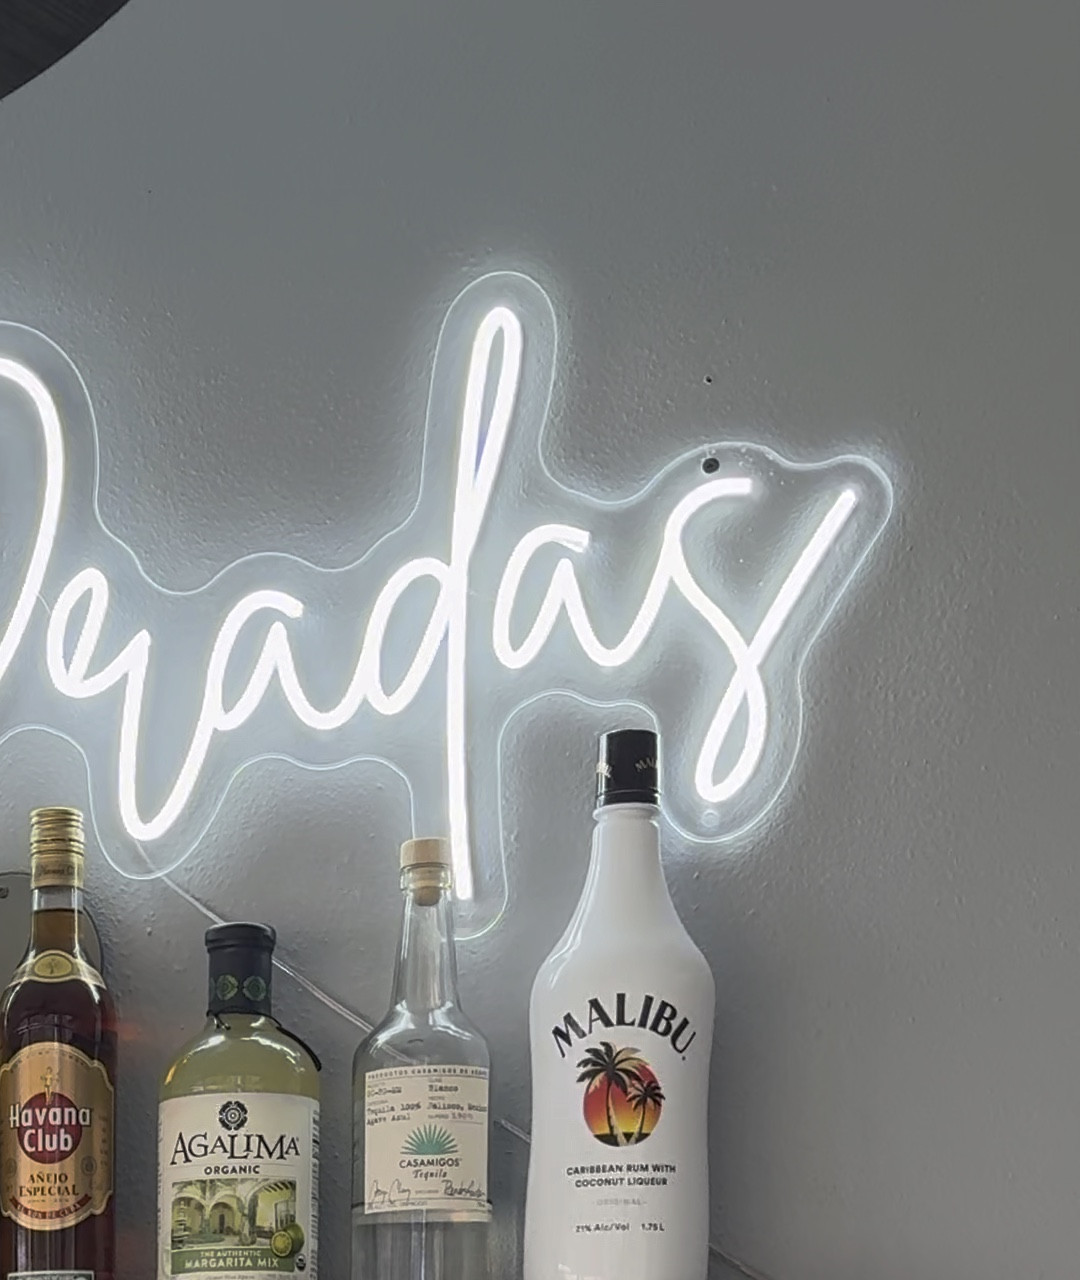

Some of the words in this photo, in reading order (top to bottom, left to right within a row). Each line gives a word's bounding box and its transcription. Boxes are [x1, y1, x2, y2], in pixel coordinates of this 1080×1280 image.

[551, 992, 697, 1059] MALIBU
[428, 1084, 459, 1093] Blanco
[9, 1103, 91, 1128] Havana
[366, 1105, 396, 1117] Tequila
[366, 1117, 387, 1127] Agave
[391, 1113, 411, 1122] Azul
[23, 1128, 73, 1152] Club
[170, 1131, 300, 1166] AGALIMA
[399, 1157, 461, 1169] CASAMIGOS
[566, 1163, 624, 1176] CARIBBEAN
[626, 1163, 650, 1173] RUM
[651, 1163, 677, 1174] WITH
[204, 1165, 261, 1176] ORGANIC
[412, 1168, 448, 1182] Tequila
[28, 1171, 69, 1184] AÑEJO
[574, 1177, 626, 1189] COCONUT
[627, 1176, 669, 1186] LIQUEUR
[19, 1184, 80, 1197] ESPECIAL
[575, 1223, 593, 1233] 21%
[593, 1222, 631, 1232] Alc/Vol
[200, 1251, 215, 1259] THE
[216, 1250, 262, 1258] AUTHENTIC
[184, 1256, 254, 1269] MARGARITA
[256, 1257, 280, 1269] MIX
